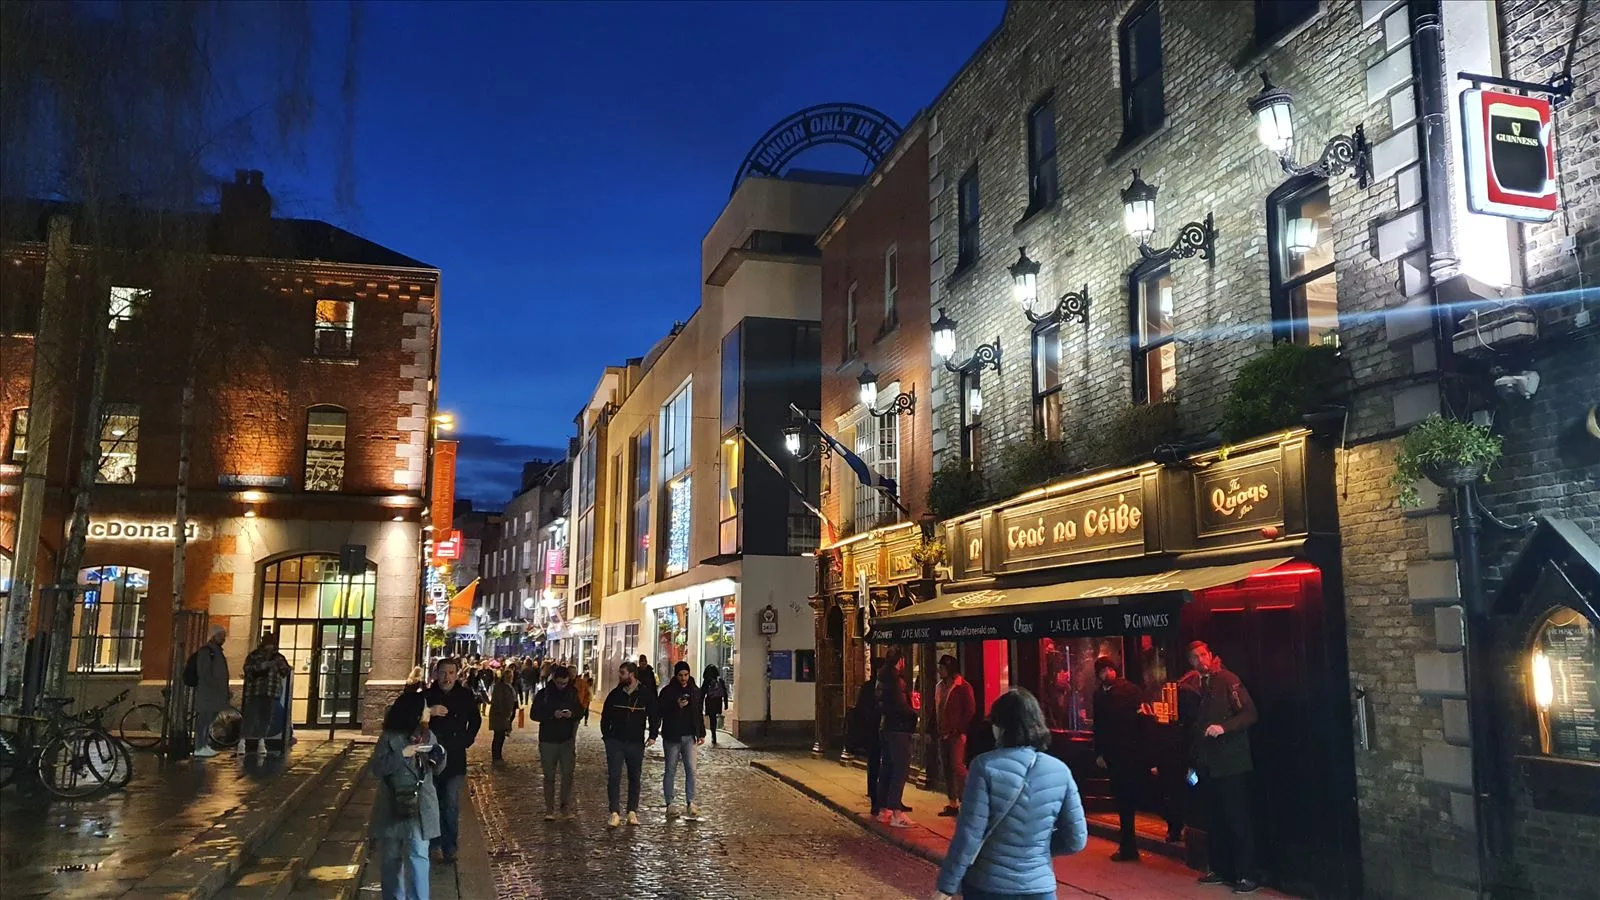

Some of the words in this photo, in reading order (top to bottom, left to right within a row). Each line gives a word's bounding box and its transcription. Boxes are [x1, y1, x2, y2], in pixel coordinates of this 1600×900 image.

[757, 122, 805, 168] UNION
[810, 113, 853, 133] ONLY
[854, 118, 875, 139] IN
[1495, 133, 1539, 147] GUINNESS
[1212, 484, 1268, 515] Quays
[1053, 520, 1077, 543] na
[1050, 618, 1072, 633] LATE
[1072, 618, 1080, 631] &
[1082, 616, 1104, 631] LIVE
[1132, 613, 1169, 629] GUINNESS
